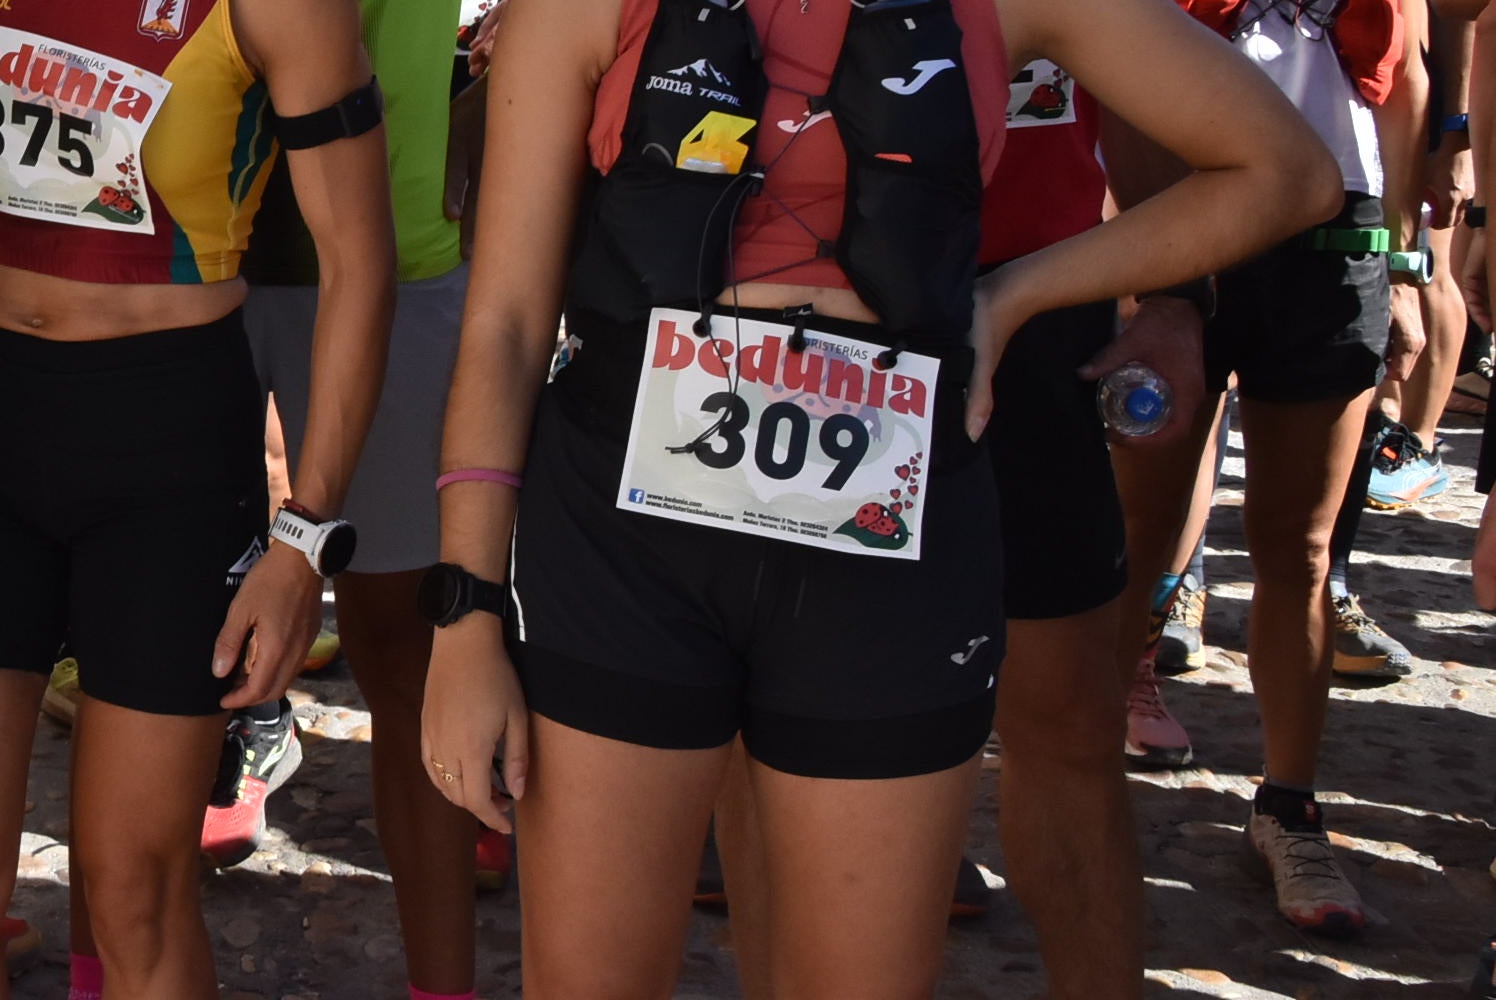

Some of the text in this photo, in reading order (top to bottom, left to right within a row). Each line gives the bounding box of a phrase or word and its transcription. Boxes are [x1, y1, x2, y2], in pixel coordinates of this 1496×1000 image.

[37, 43, 107, 72] FLORISTERÍAS
[652, 319, 927, 418] bedunia
[804, 338, 868, 361] RISTERÍAS
[694, 392, 870, 491] 309
